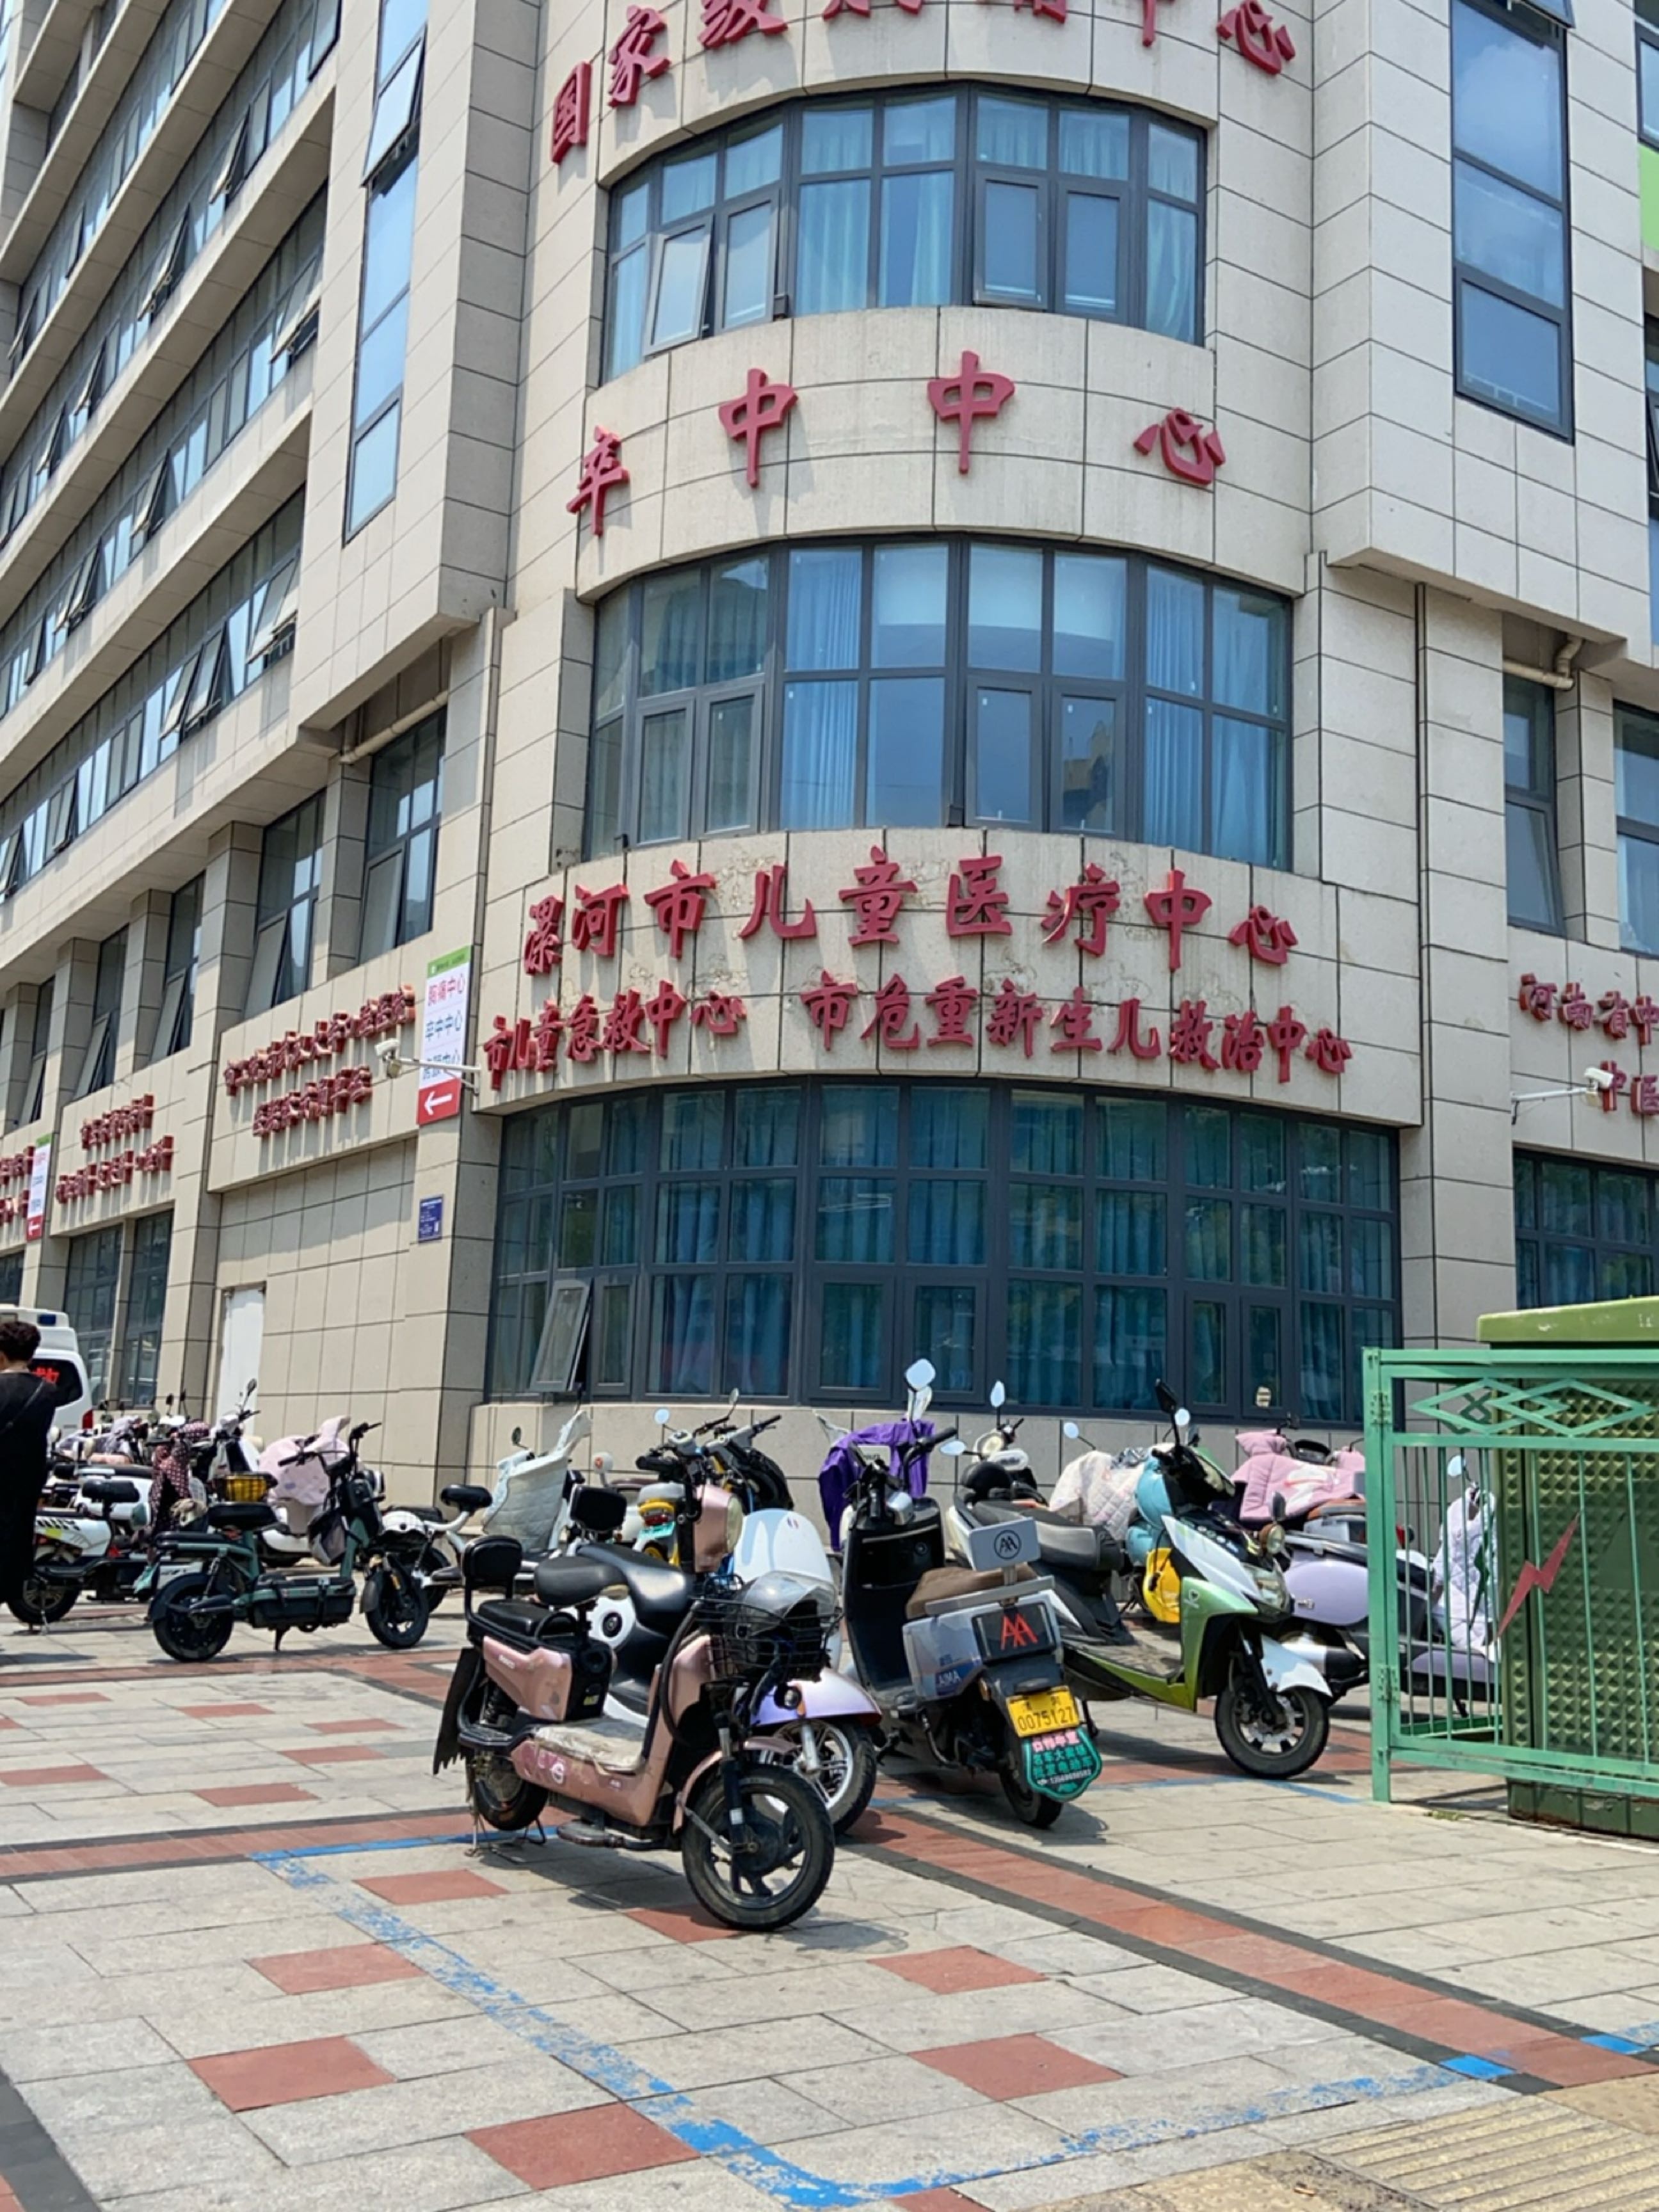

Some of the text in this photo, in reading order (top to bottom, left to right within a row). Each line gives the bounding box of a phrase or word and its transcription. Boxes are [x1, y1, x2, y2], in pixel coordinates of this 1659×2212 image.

[567, 349, 1226, 537] 卒中中心
[524, 845, 1298, 975] 漯河市儿童医疗中心
[801, 970, 1352, 1083] 市危重新生儿救治中心
